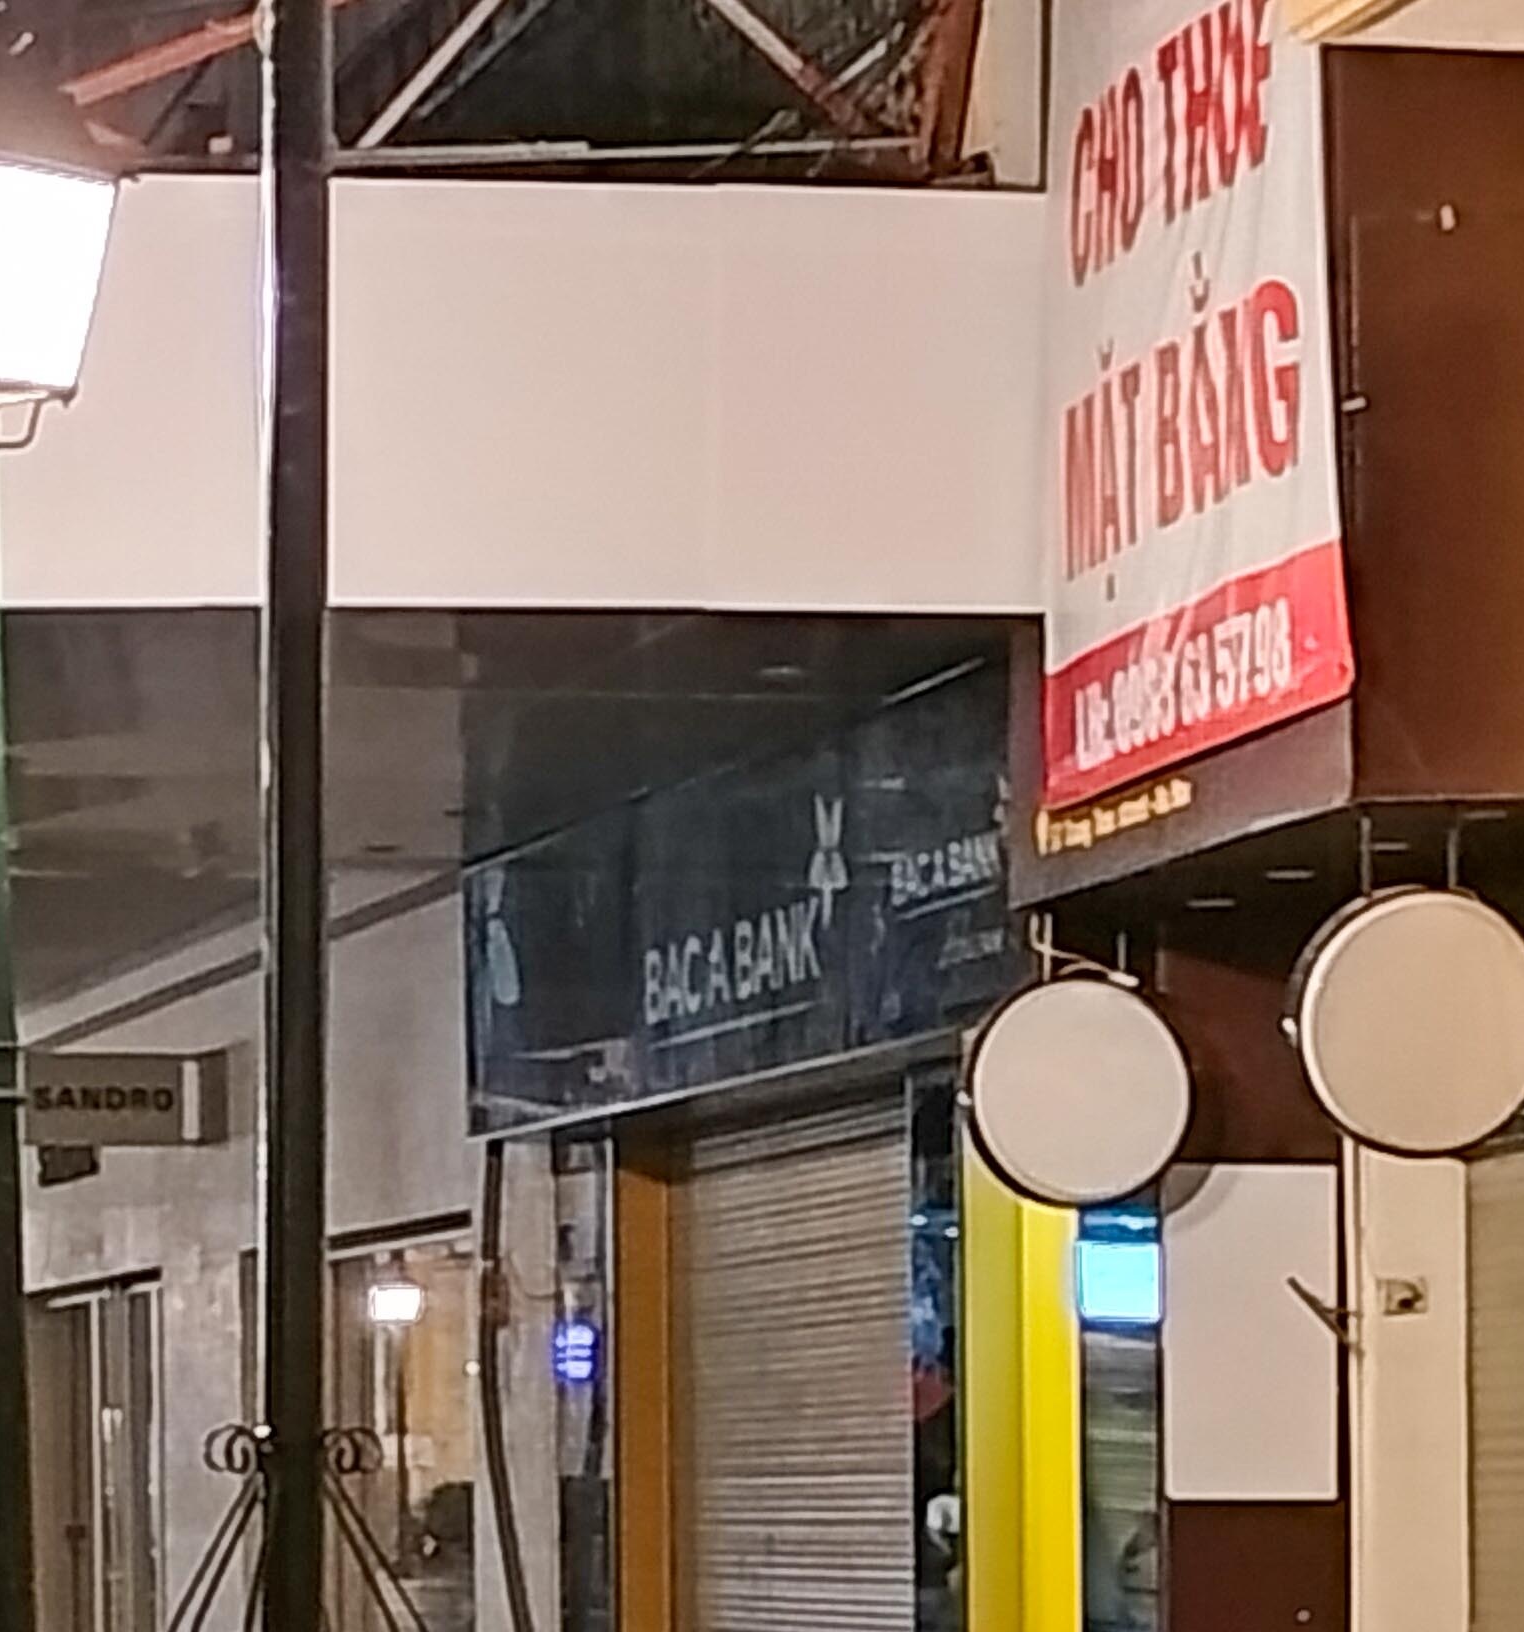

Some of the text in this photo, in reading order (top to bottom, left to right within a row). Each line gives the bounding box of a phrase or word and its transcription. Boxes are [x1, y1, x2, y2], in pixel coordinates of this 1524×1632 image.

[1071, 66, 1145, 287] CHO
[1066, 337, 1141, 602] MẶT
[734, 896, 822, 1000] BANK
[33, 1085, 174, 1112] SANDRO
